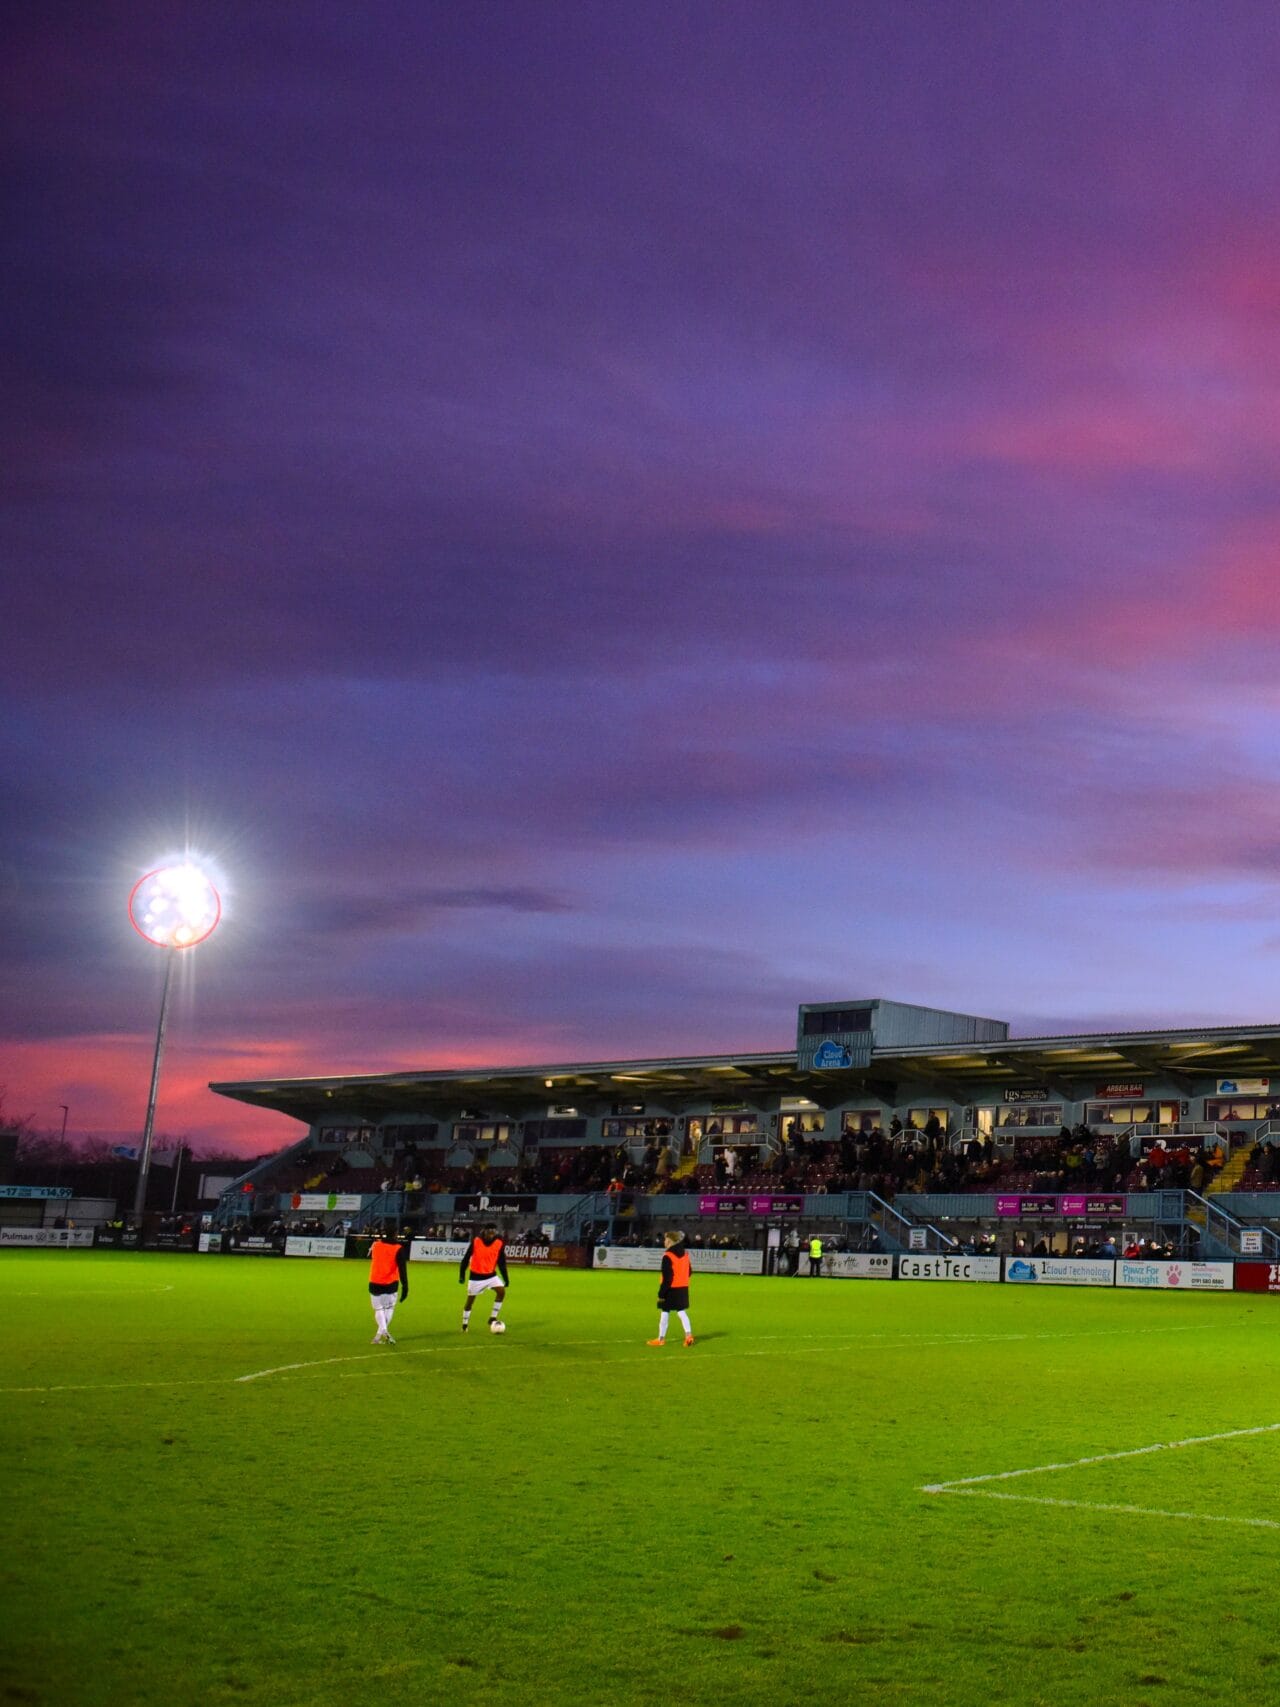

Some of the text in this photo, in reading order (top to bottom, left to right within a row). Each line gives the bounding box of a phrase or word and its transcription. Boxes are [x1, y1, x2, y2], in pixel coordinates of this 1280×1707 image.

[2, 1232, 33, 1241] Pulman
[503, 1245, 549, 1259] RBEIA BAR
[1069, 1265, 1111, 1279] Technology
[1123, 1265, 1159, 1276] Pawz For
[1123, 1275, 1159, 1285] Thought
